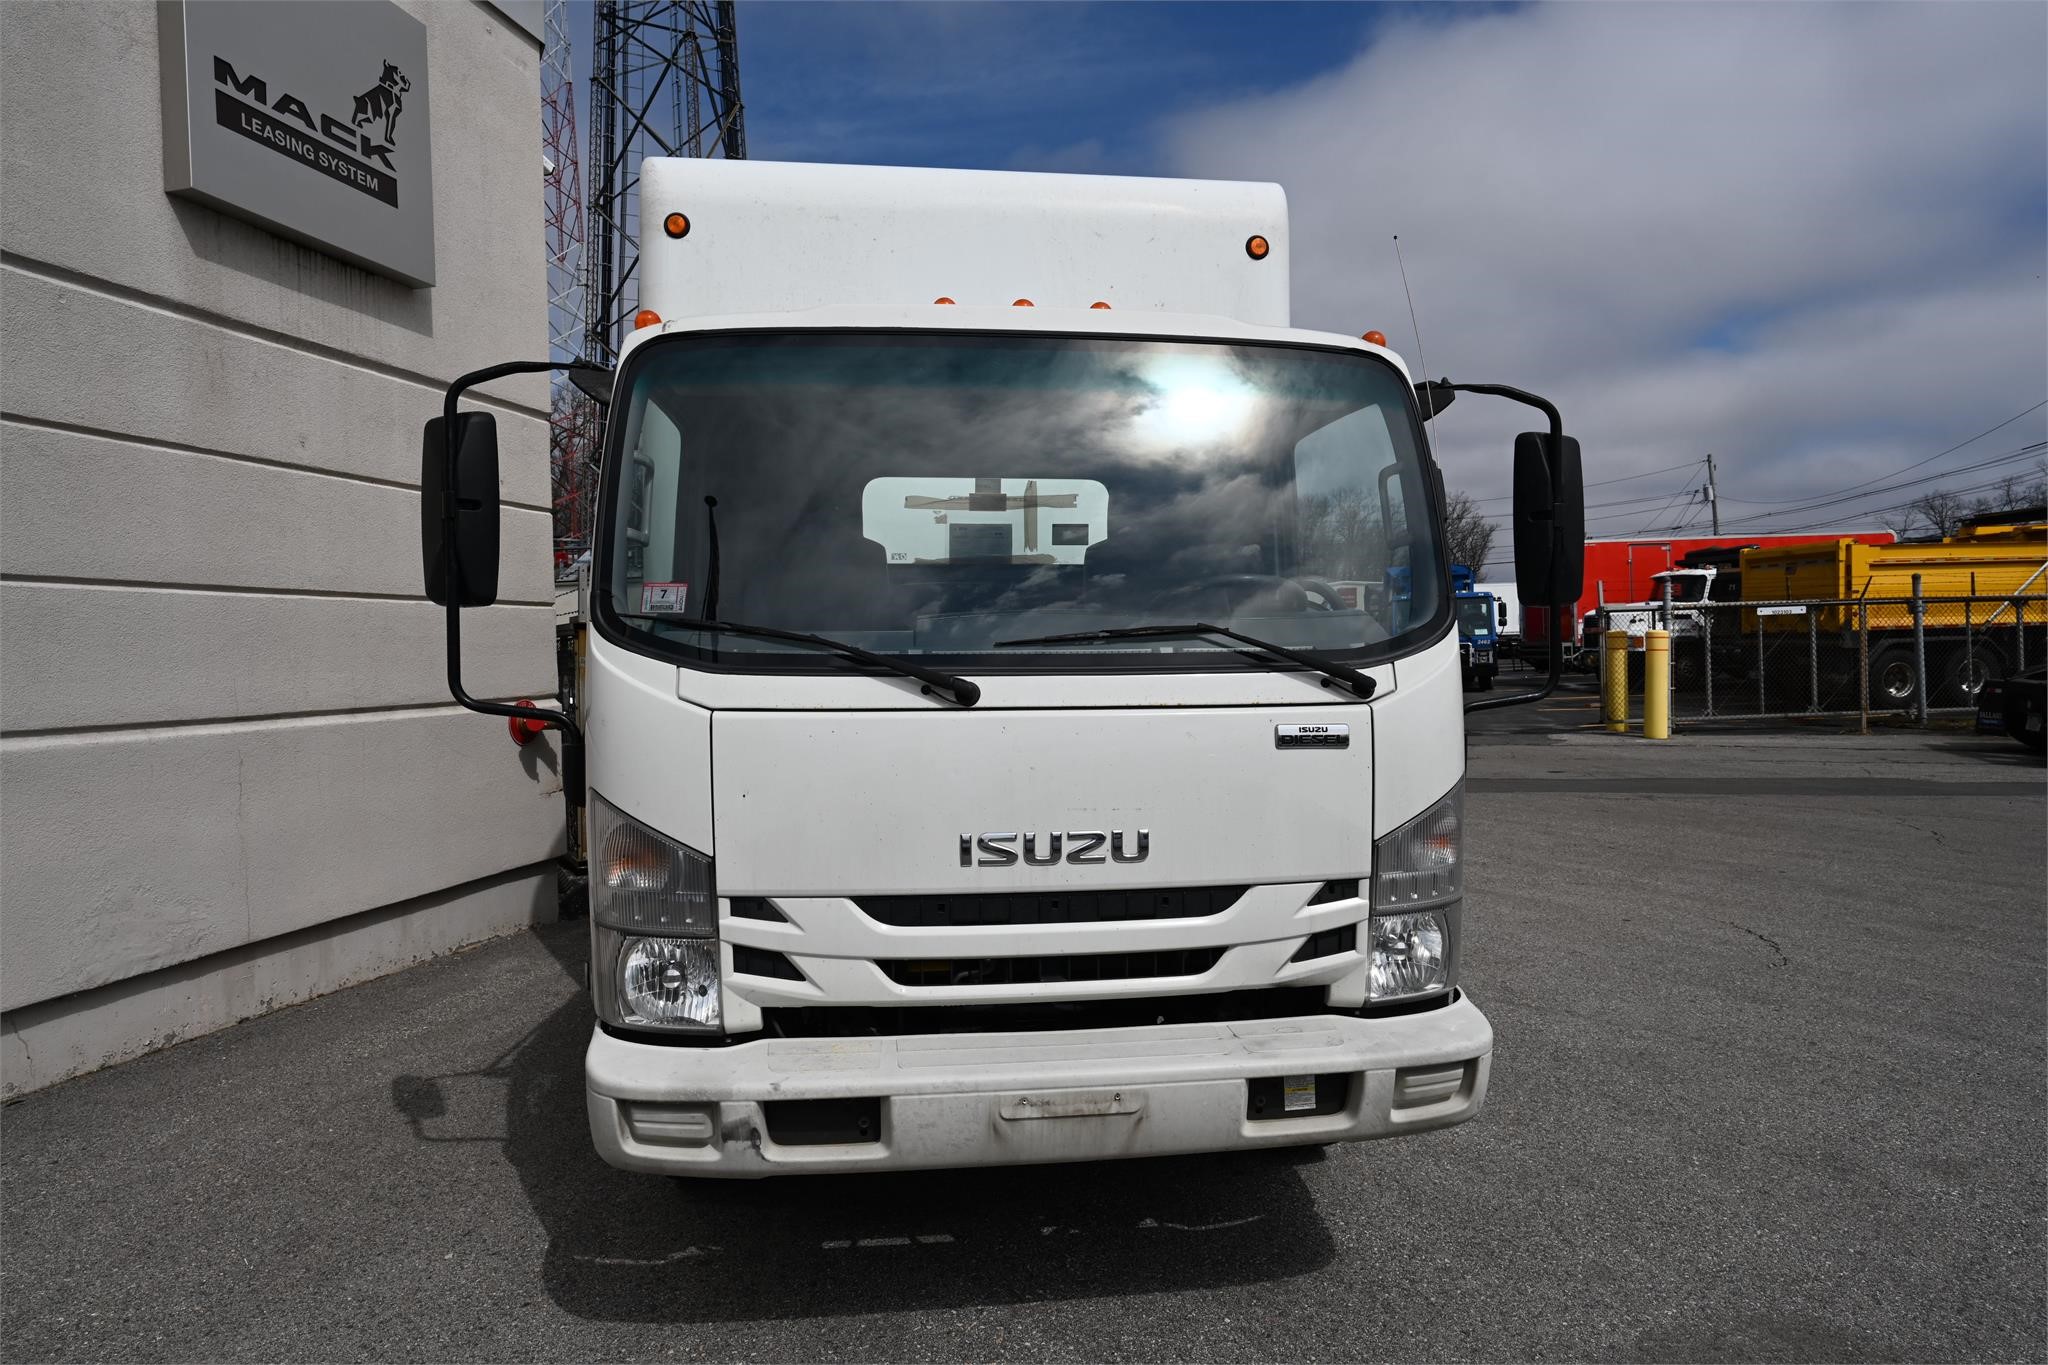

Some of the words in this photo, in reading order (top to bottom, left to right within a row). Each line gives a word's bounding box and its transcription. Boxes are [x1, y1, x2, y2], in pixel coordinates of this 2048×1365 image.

[213, 55, 397, 173] MACK
[241, 112, 315, 161] LEASING
[319, 151, 379, 192] SYSTEM
[660, 589, 668, 599] 7
[1281, 734, 1348, 744] DIESEL
[960, 829, 1149, 867] ISUZU
